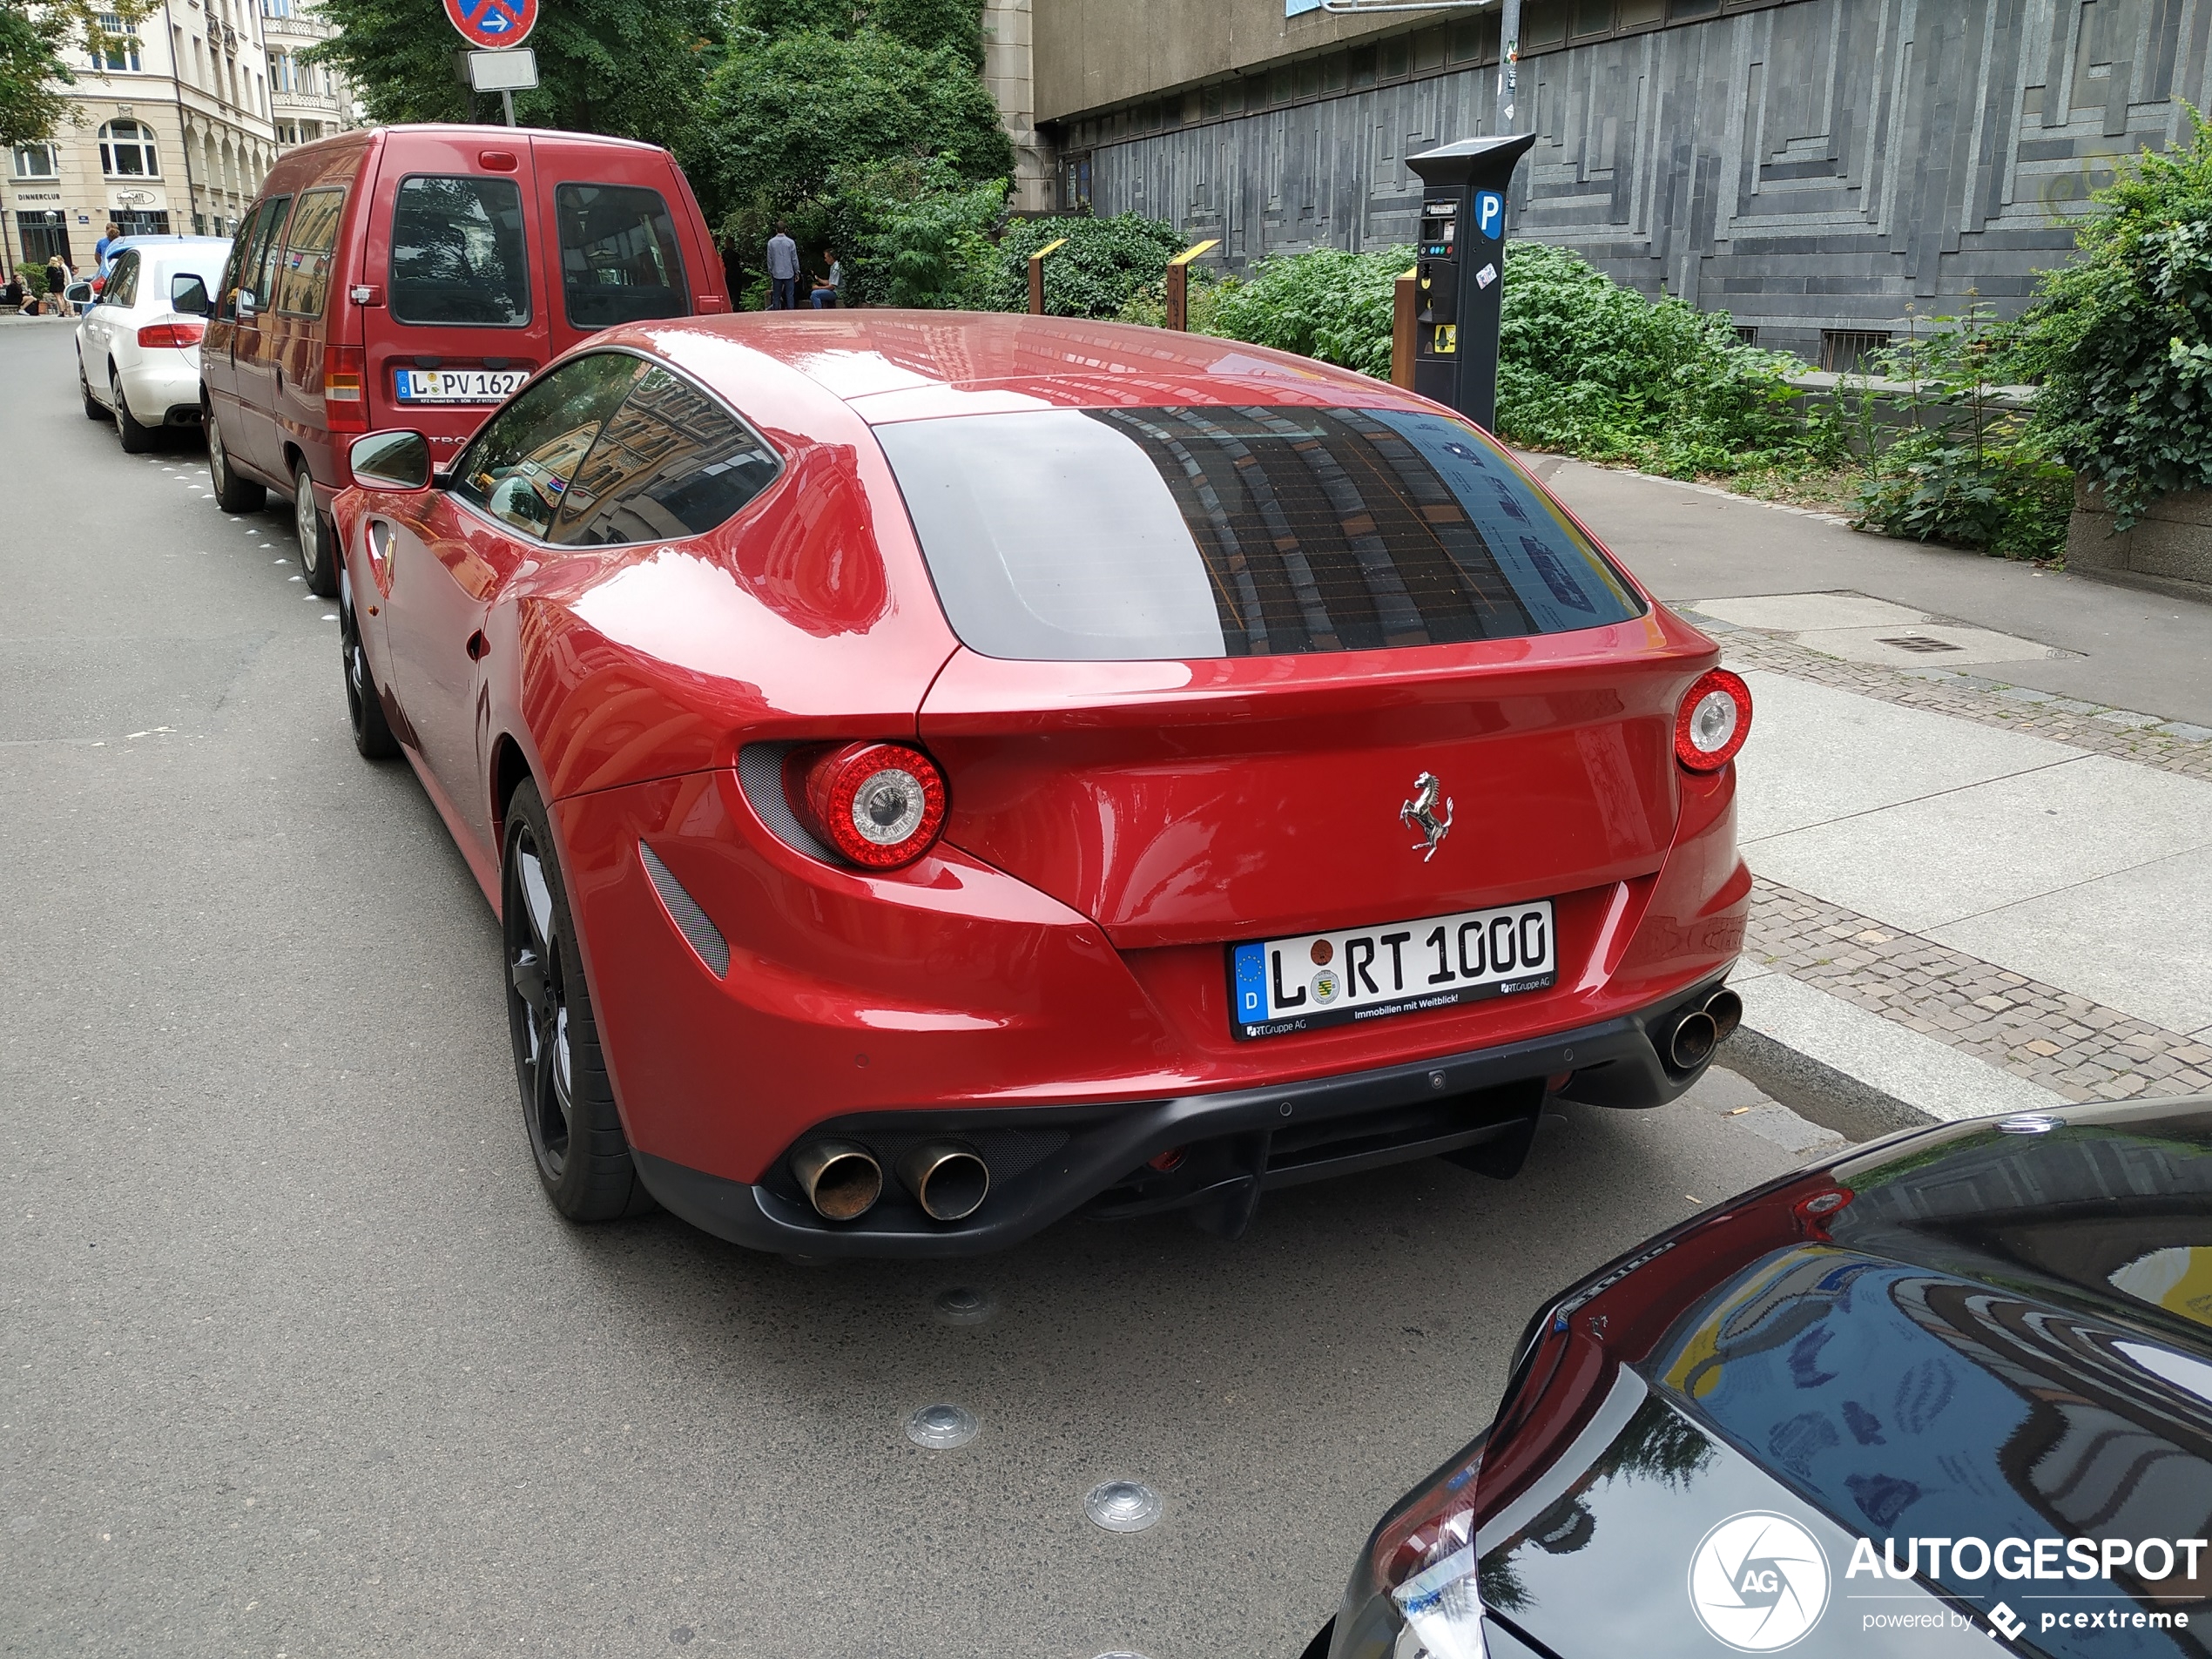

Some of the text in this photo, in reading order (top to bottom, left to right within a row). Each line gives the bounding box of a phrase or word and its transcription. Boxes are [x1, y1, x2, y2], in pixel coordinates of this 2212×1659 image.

[1480, 196, 1499, 230] P
[412, 374, 427, 395] L
[442, 374, 469, 395] PV
[1271, 949, 1306, 1009] L
[1345, 931, 1411, 998] RT
[1426, 911, 1546, 985] 1000
[1540, 977, 1549, 987] AG
[1245, 992, 1258, 1010] D
[1354, 994, 1459, 1020] Immobilien mit Weitblick!
[1294, 1020, 1306, 1030] AG
